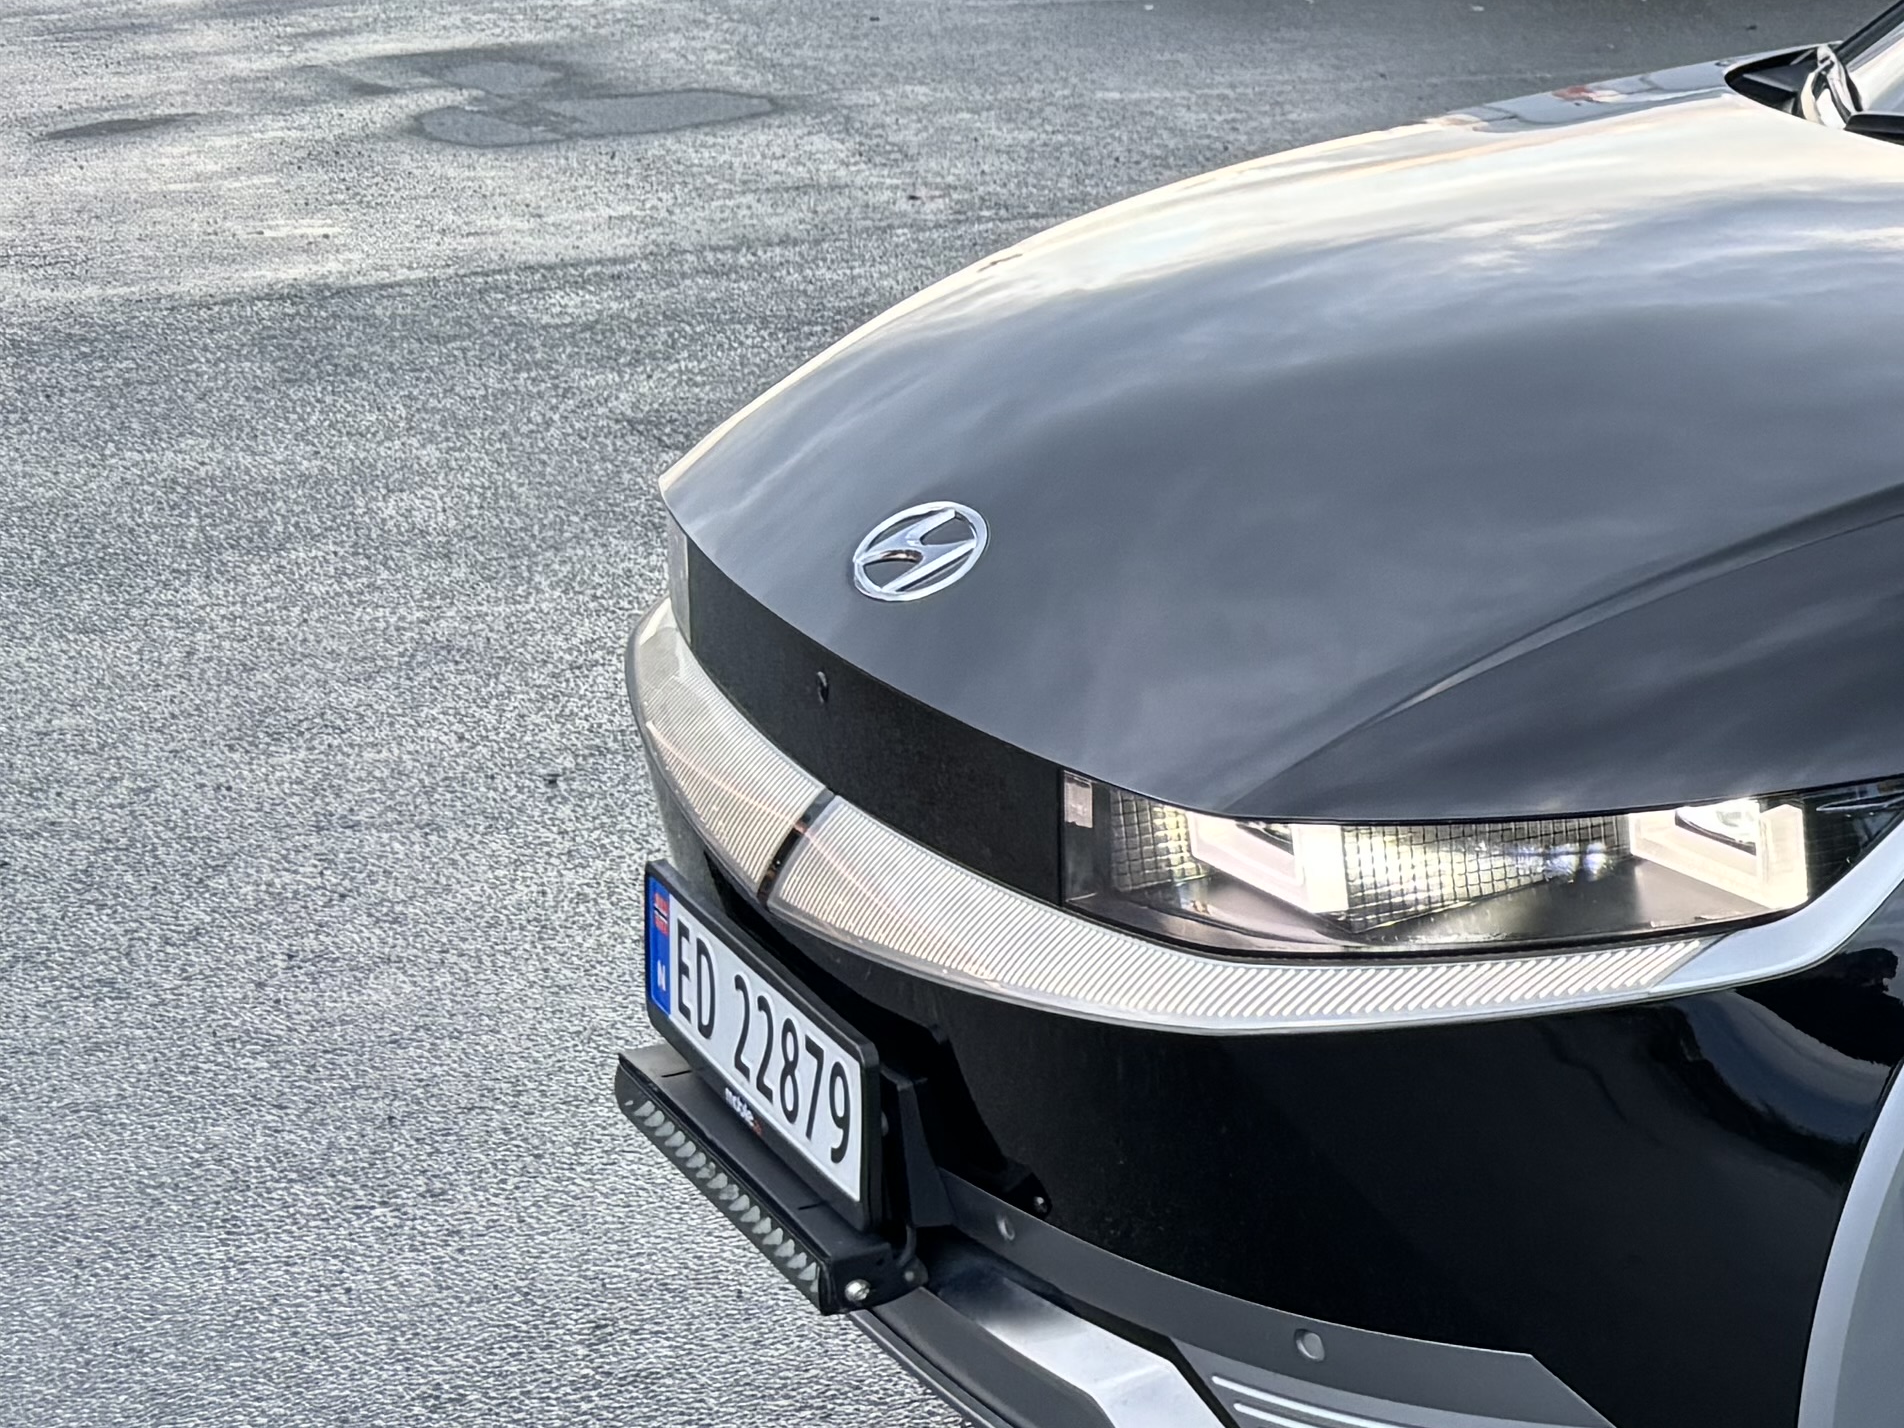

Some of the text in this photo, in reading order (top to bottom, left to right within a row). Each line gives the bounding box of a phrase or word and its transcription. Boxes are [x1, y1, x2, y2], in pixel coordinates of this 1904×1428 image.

[657, 959, 667, 993] N
[677, 917, 851, 1165] ED 22879
